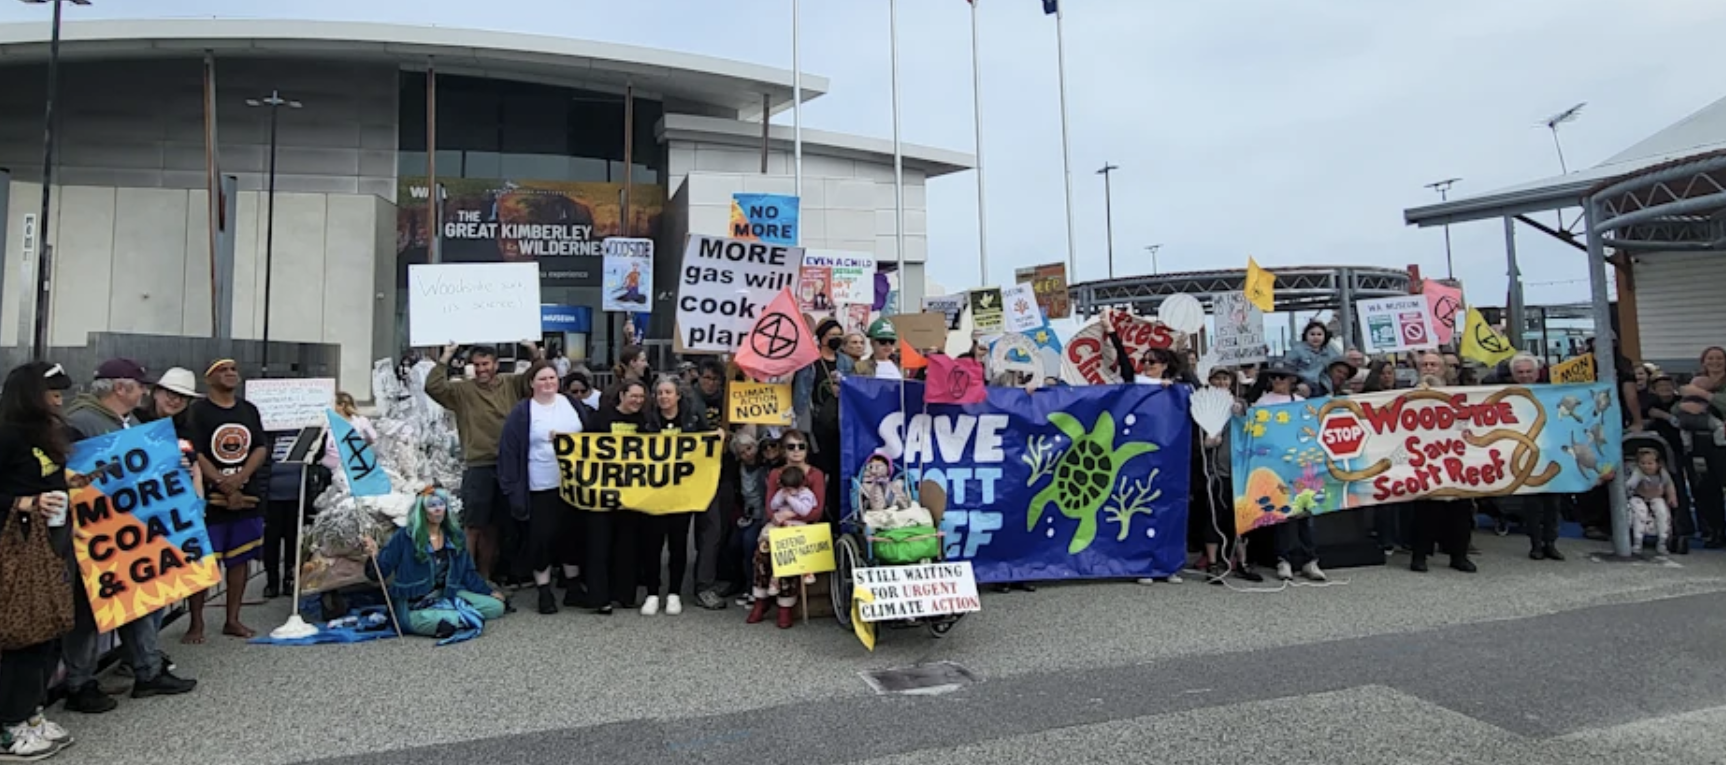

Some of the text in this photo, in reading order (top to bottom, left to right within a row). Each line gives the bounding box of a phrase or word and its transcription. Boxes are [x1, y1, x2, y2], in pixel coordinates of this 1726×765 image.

[457, 210, 481, 223] THE
[749, 205, 779, 219] NO
[444, 223, 592, 240] GREAT KIMBERLEY
[733, 222, 793, 239] MORE
[518, 240, 606, 256] WILDERNE
[698, 237, 789, 267] MORE
[806, 256, 873, 268] EVEN A CHILD
[416, 271, 493, 297] Woodside
[684, 265, 734, 285] gas
[744, 271, 793, 291] will
[680, 295, 757, 319] cook
[1367, 303, 1383, 312] WA
[733, 386, 775, 399] CLIMATE
[741, 394, 777, 406] ACTION
[736, 403, 778, 420] NOW
[553, 433, 722, 462] DISRUPT
[878, 411, 1009, 464] SAVE
[1323, 427, 1363, 445] STOP
[1405, 436, 1466, 467] Save
[95, 448, 149, 486] NO
[557, 458, 695, 488] BURRUP
[1443, 448, 1505, 486] Reef
[75, 470, 185, 529] MORE
[561, 486, 622, 509] HUB
[88, 507, 193, 562] COAL
[98, 537, 204, 599] & GAS
[855, 565, 963, 585] STILL WAITING
[870, 581, 957, 600] FOR URGENT
[861, 595, 980, 619] CLIMATE ACTION
